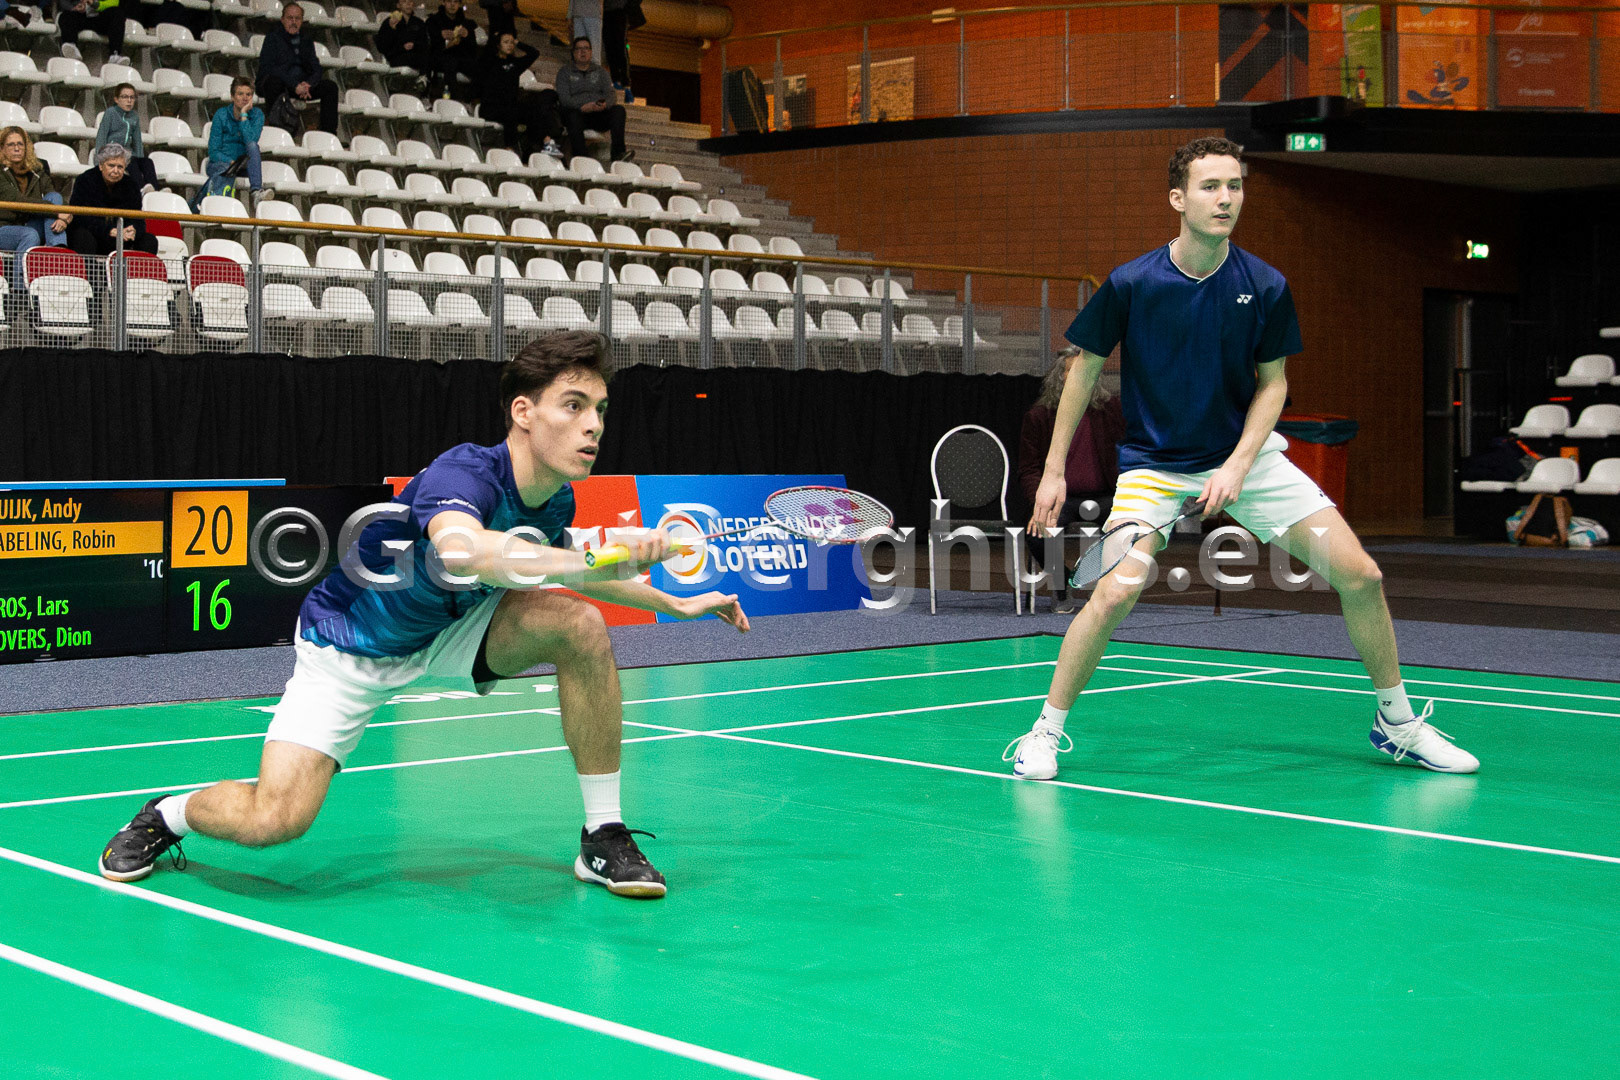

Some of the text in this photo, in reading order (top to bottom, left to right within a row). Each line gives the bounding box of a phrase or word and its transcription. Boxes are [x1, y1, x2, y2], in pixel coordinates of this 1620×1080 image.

[42, 498, 82, 523] Andy
[73, 529, 115, 549] Robin
[185, 505, 233, 555] 20
[711, 544, 808, 573] LOTERIJ
[37, 596, 69, 616] Lars
[186, 579, 232, 631] 16
[57, 627, 91, 647] Dion
